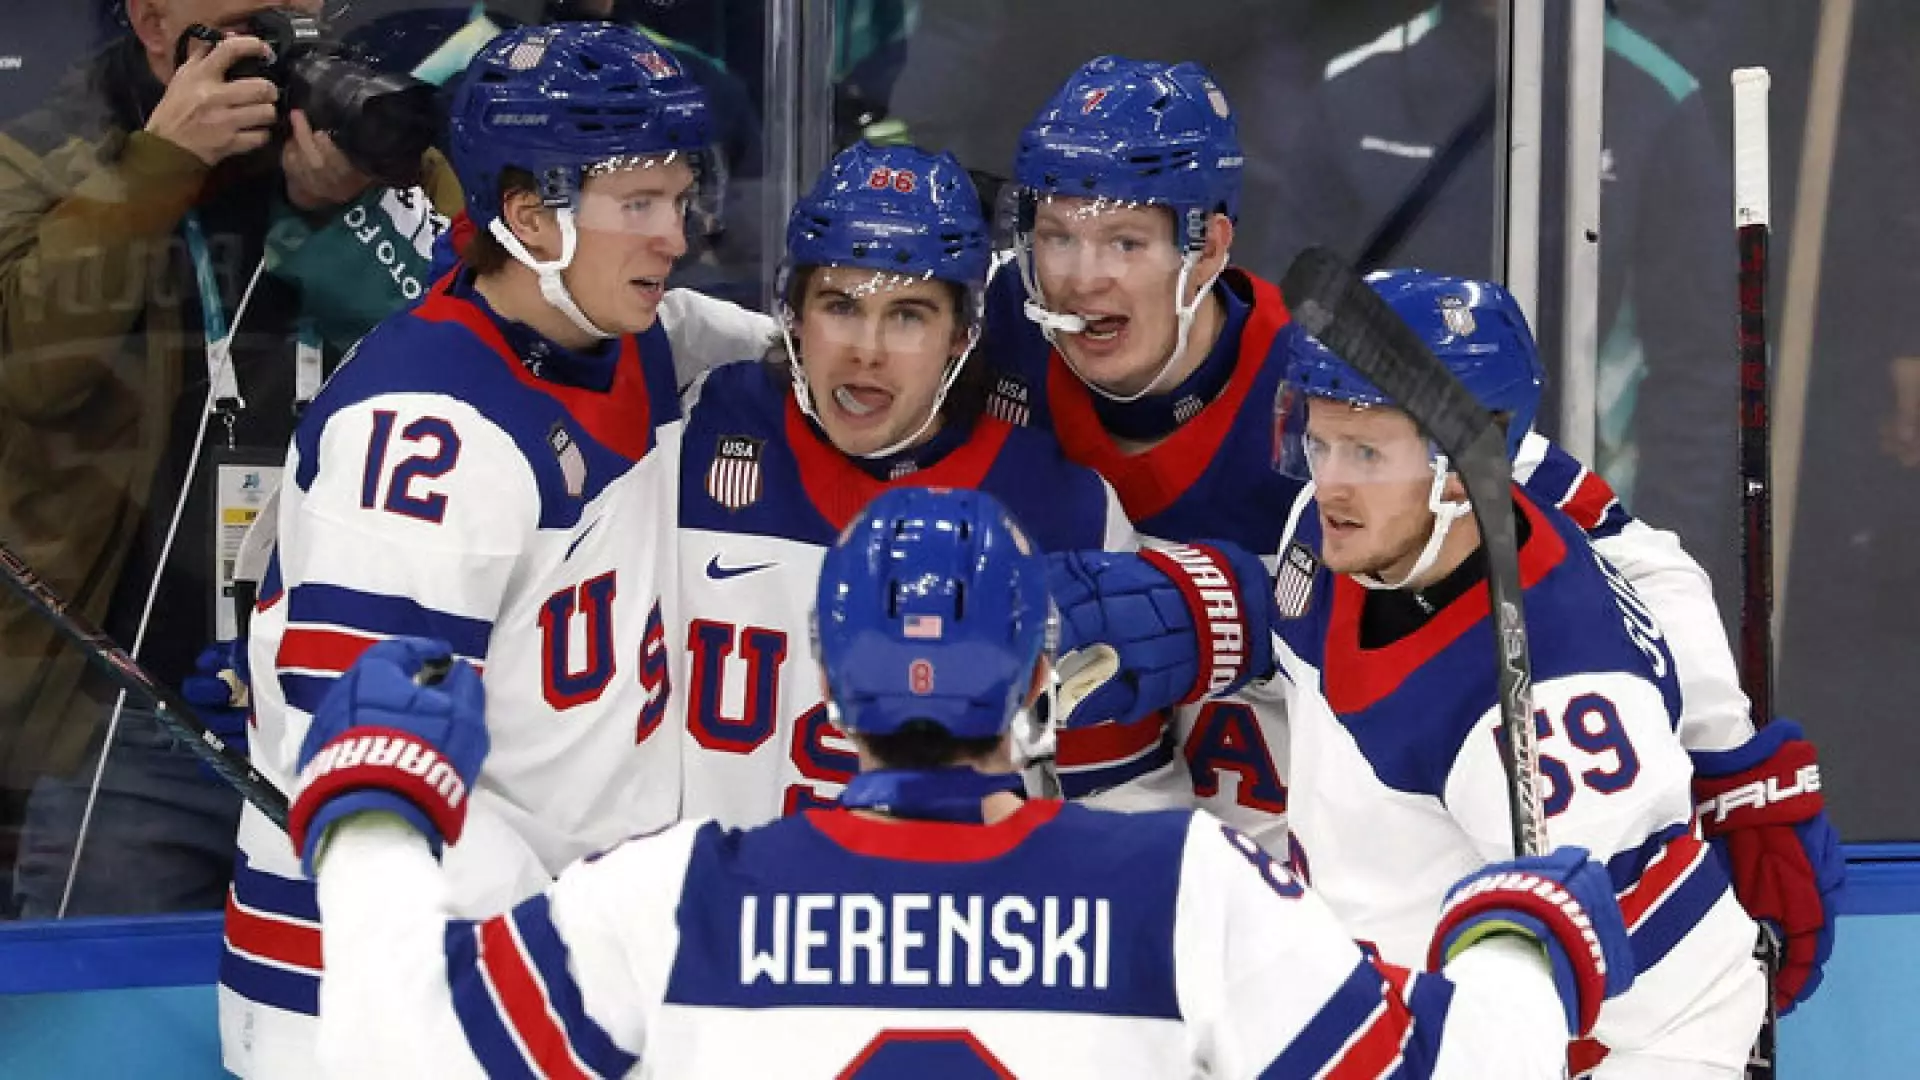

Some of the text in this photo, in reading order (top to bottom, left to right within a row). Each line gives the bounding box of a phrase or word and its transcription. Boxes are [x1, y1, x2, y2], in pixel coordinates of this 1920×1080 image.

[376, 239, 431, 299] OTO
[997, 378, 1028, 403] USA
[361, 409, 461, 523] 12
[722, 440, 753, 457] USA
[908, 658, 933, 694] 8
[1493, 692, 1640, 818] 59
[739, 894, 1110, 988] WERENSKI
